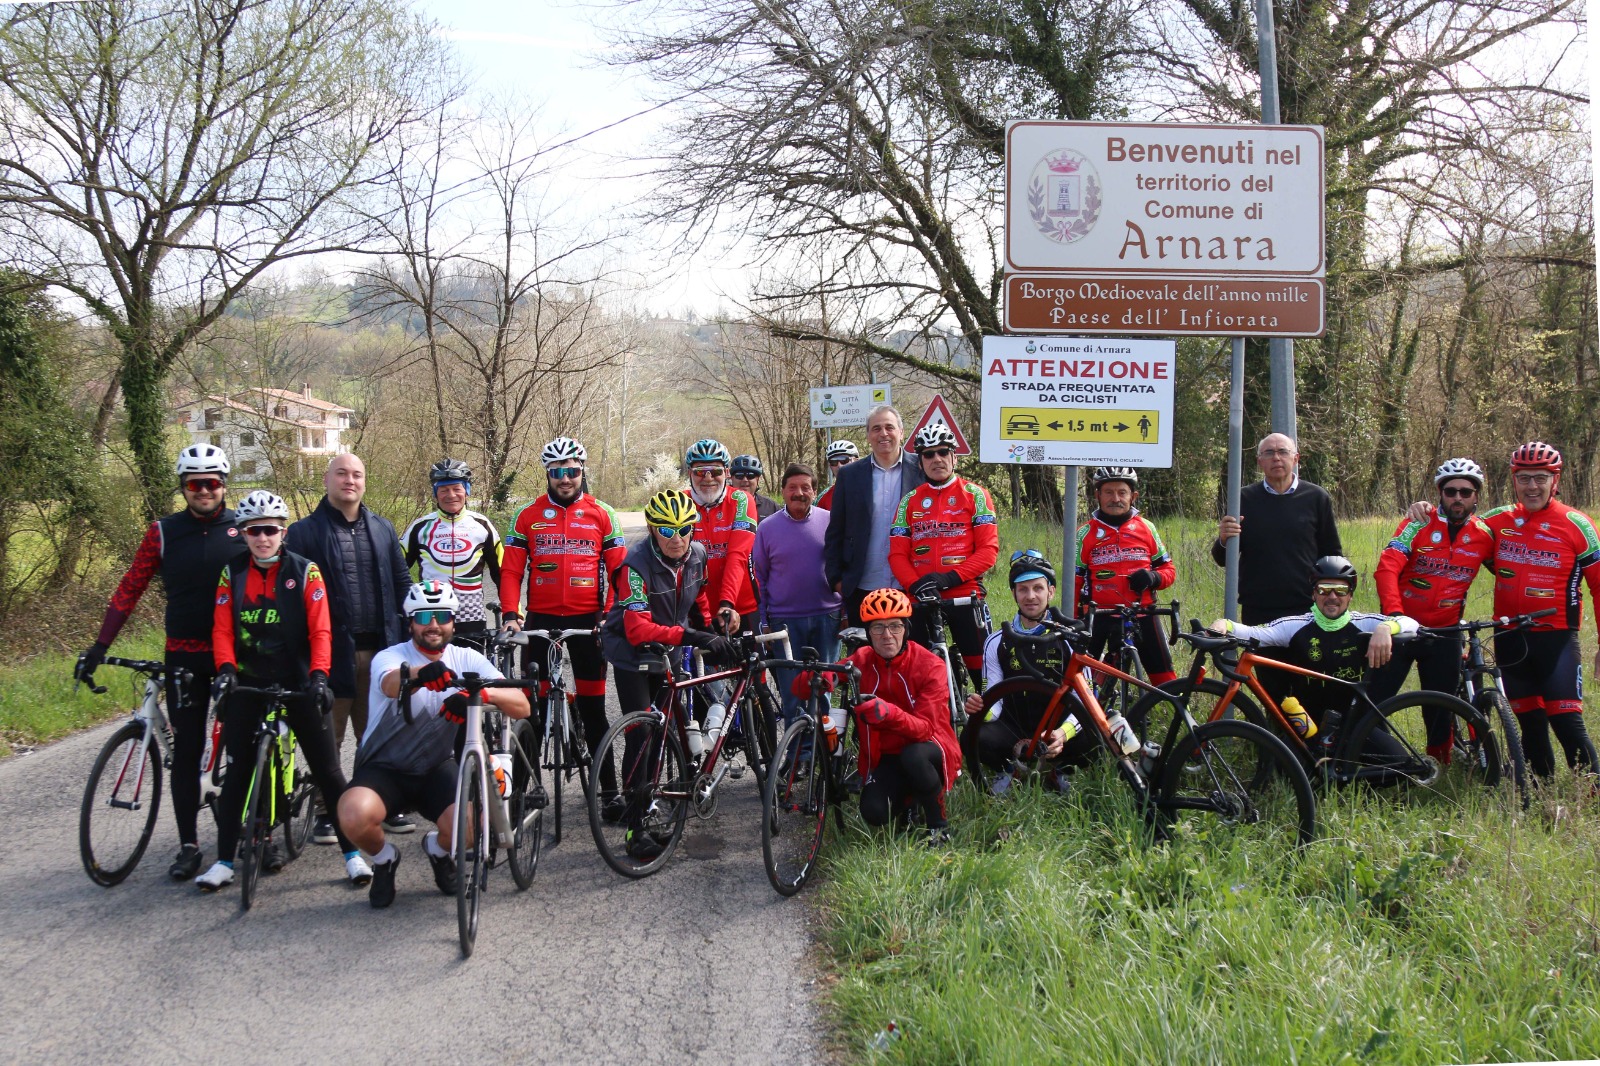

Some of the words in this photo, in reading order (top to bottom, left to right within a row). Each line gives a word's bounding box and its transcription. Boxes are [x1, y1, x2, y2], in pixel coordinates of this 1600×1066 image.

[1106, 137, 1254, 166] Benvenuti
[1265, 144, 1301, 166] nel
[1136, 173, 1230, 192] territorio
[1241, 175, 1274, 192] del
[1144, 200, 1234, 220] Comune
[1244, 202, 1263, 220] di
[1118, 219, 1276, 262] Arnara
[1020, 282, 1076, 306] Borgo
[1079, 282, 1178, 301] Medioevale
[1266, 286, 1308, 303] mille
[1050, 308, 1111, 325] Paese
[1122, 309, 1168, 326] dell'
[1179, 310, 1278, 328] Infiorata
[1040, 343, 1080, 353] Comune
[1082, 344, 1094, 354] di
[1096, 345, 1132, 354] Arnara
[988, 358, 1168, 380] ATTENZIONE
[1001, 382, 1056, 392] STRADA
[1058, 382, 1156, 394] FREQUENTATA
[1038, 393, 1058, 403] DA
[1060, 394, 1117, 404] CICLISTI
[1067, 420, 1085, 432] 1,5
[1090, 421, 1109, 432] mt
